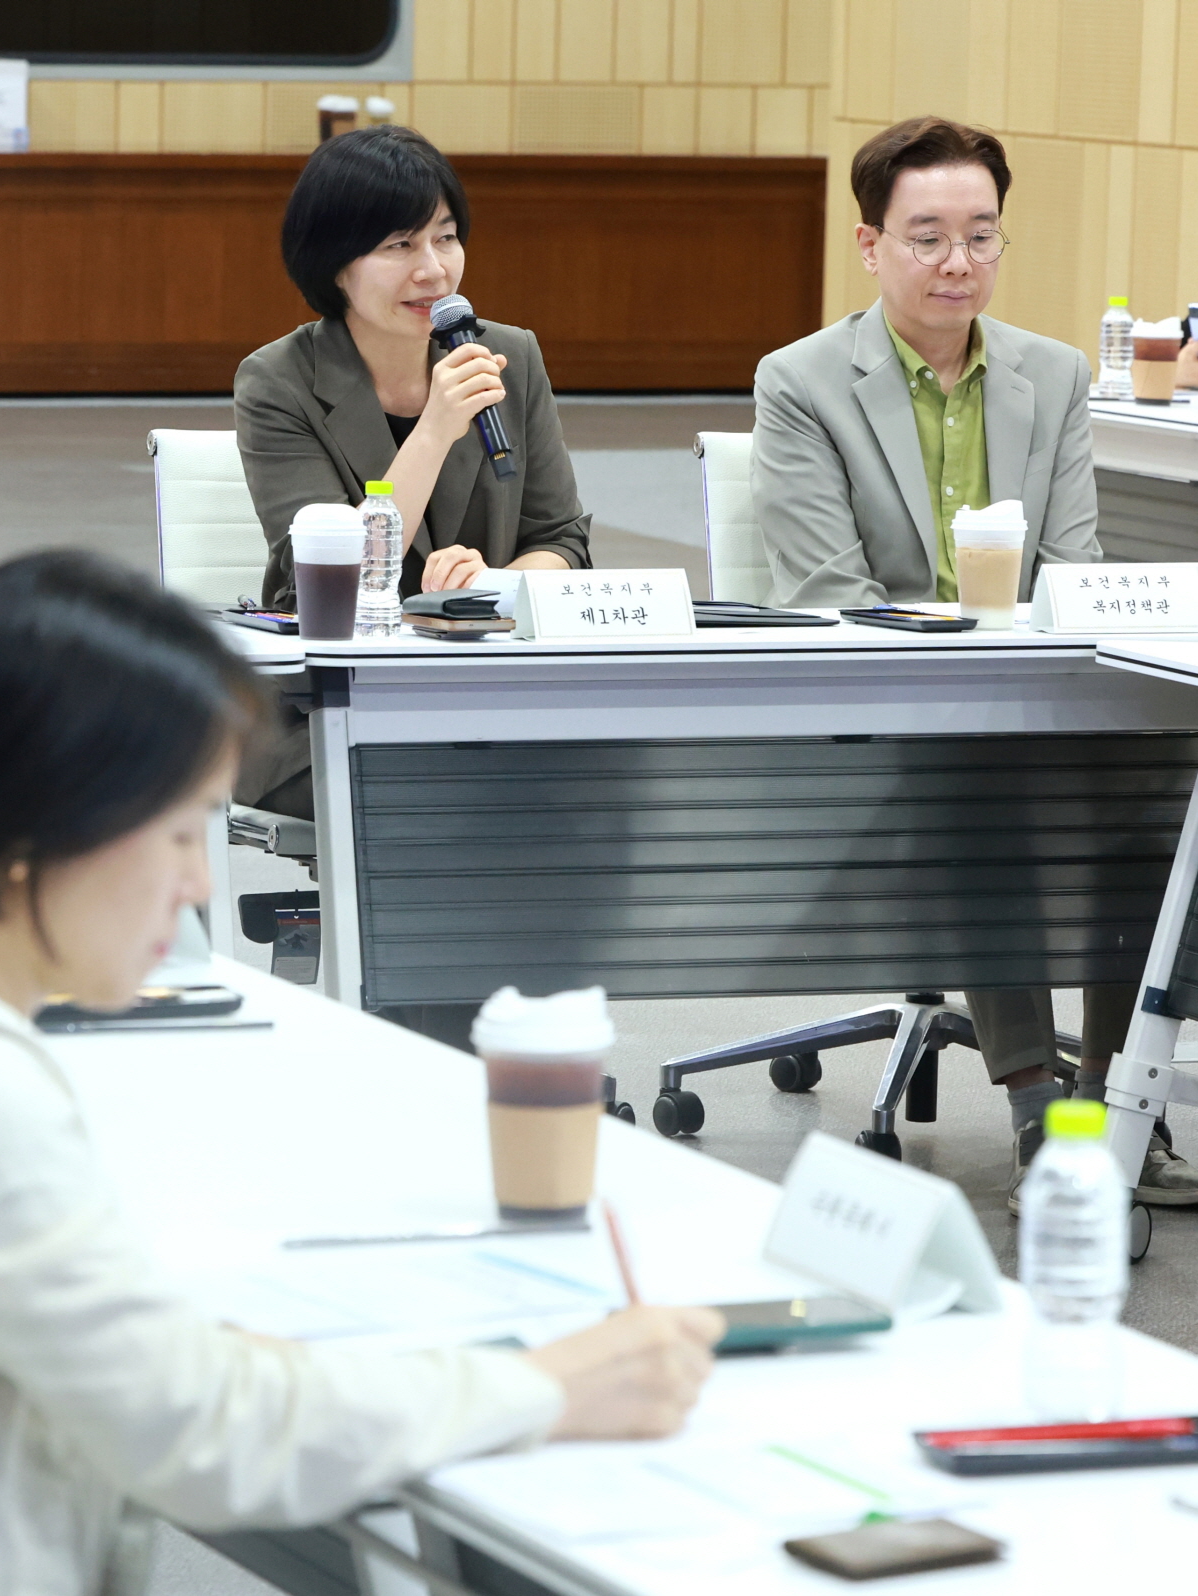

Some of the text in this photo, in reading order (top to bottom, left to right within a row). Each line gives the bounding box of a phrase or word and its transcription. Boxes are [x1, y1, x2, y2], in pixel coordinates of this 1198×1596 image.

[561, 582, 654, 597] 보건복지부
[1079, 575, 1171, 589] 보건복지부
[1092, 599, 1171, 615] 복지정책관
[580, 606, 649, 626] 제1차관
